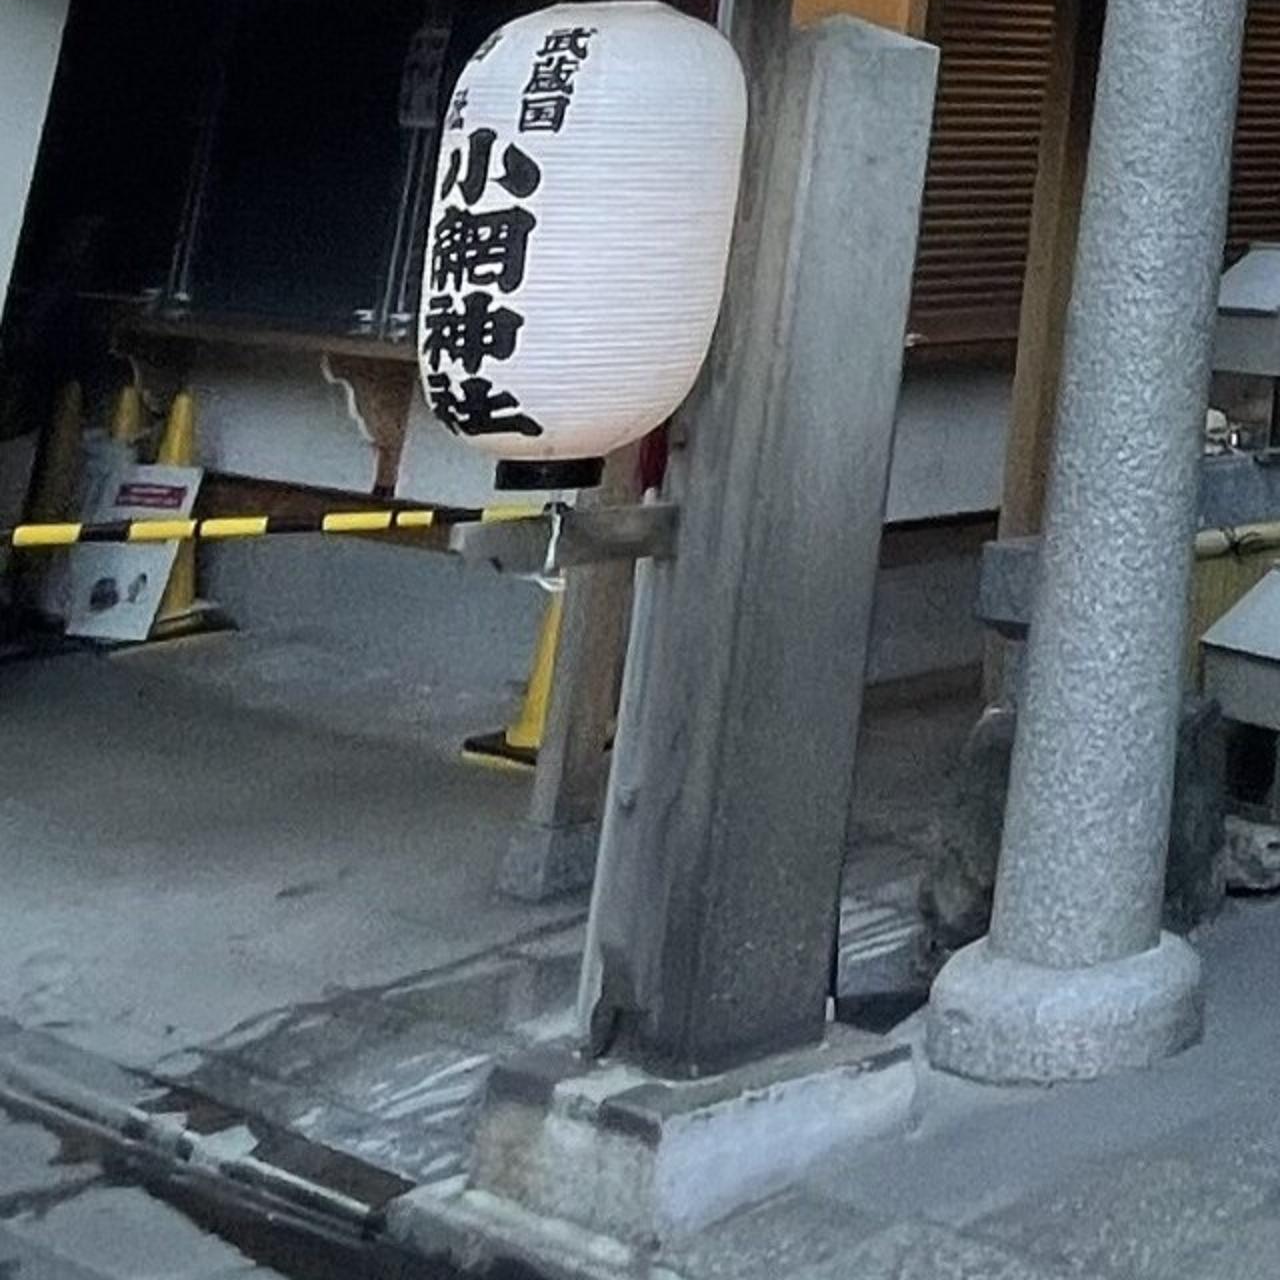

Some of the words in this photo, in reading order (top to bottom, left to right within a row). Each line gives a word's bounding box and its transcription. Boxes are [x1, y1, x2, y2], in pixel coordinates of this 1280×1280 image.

[518, 27, 597, 134] 武蔵国
[424, 127, 543, 436] 小網神社
